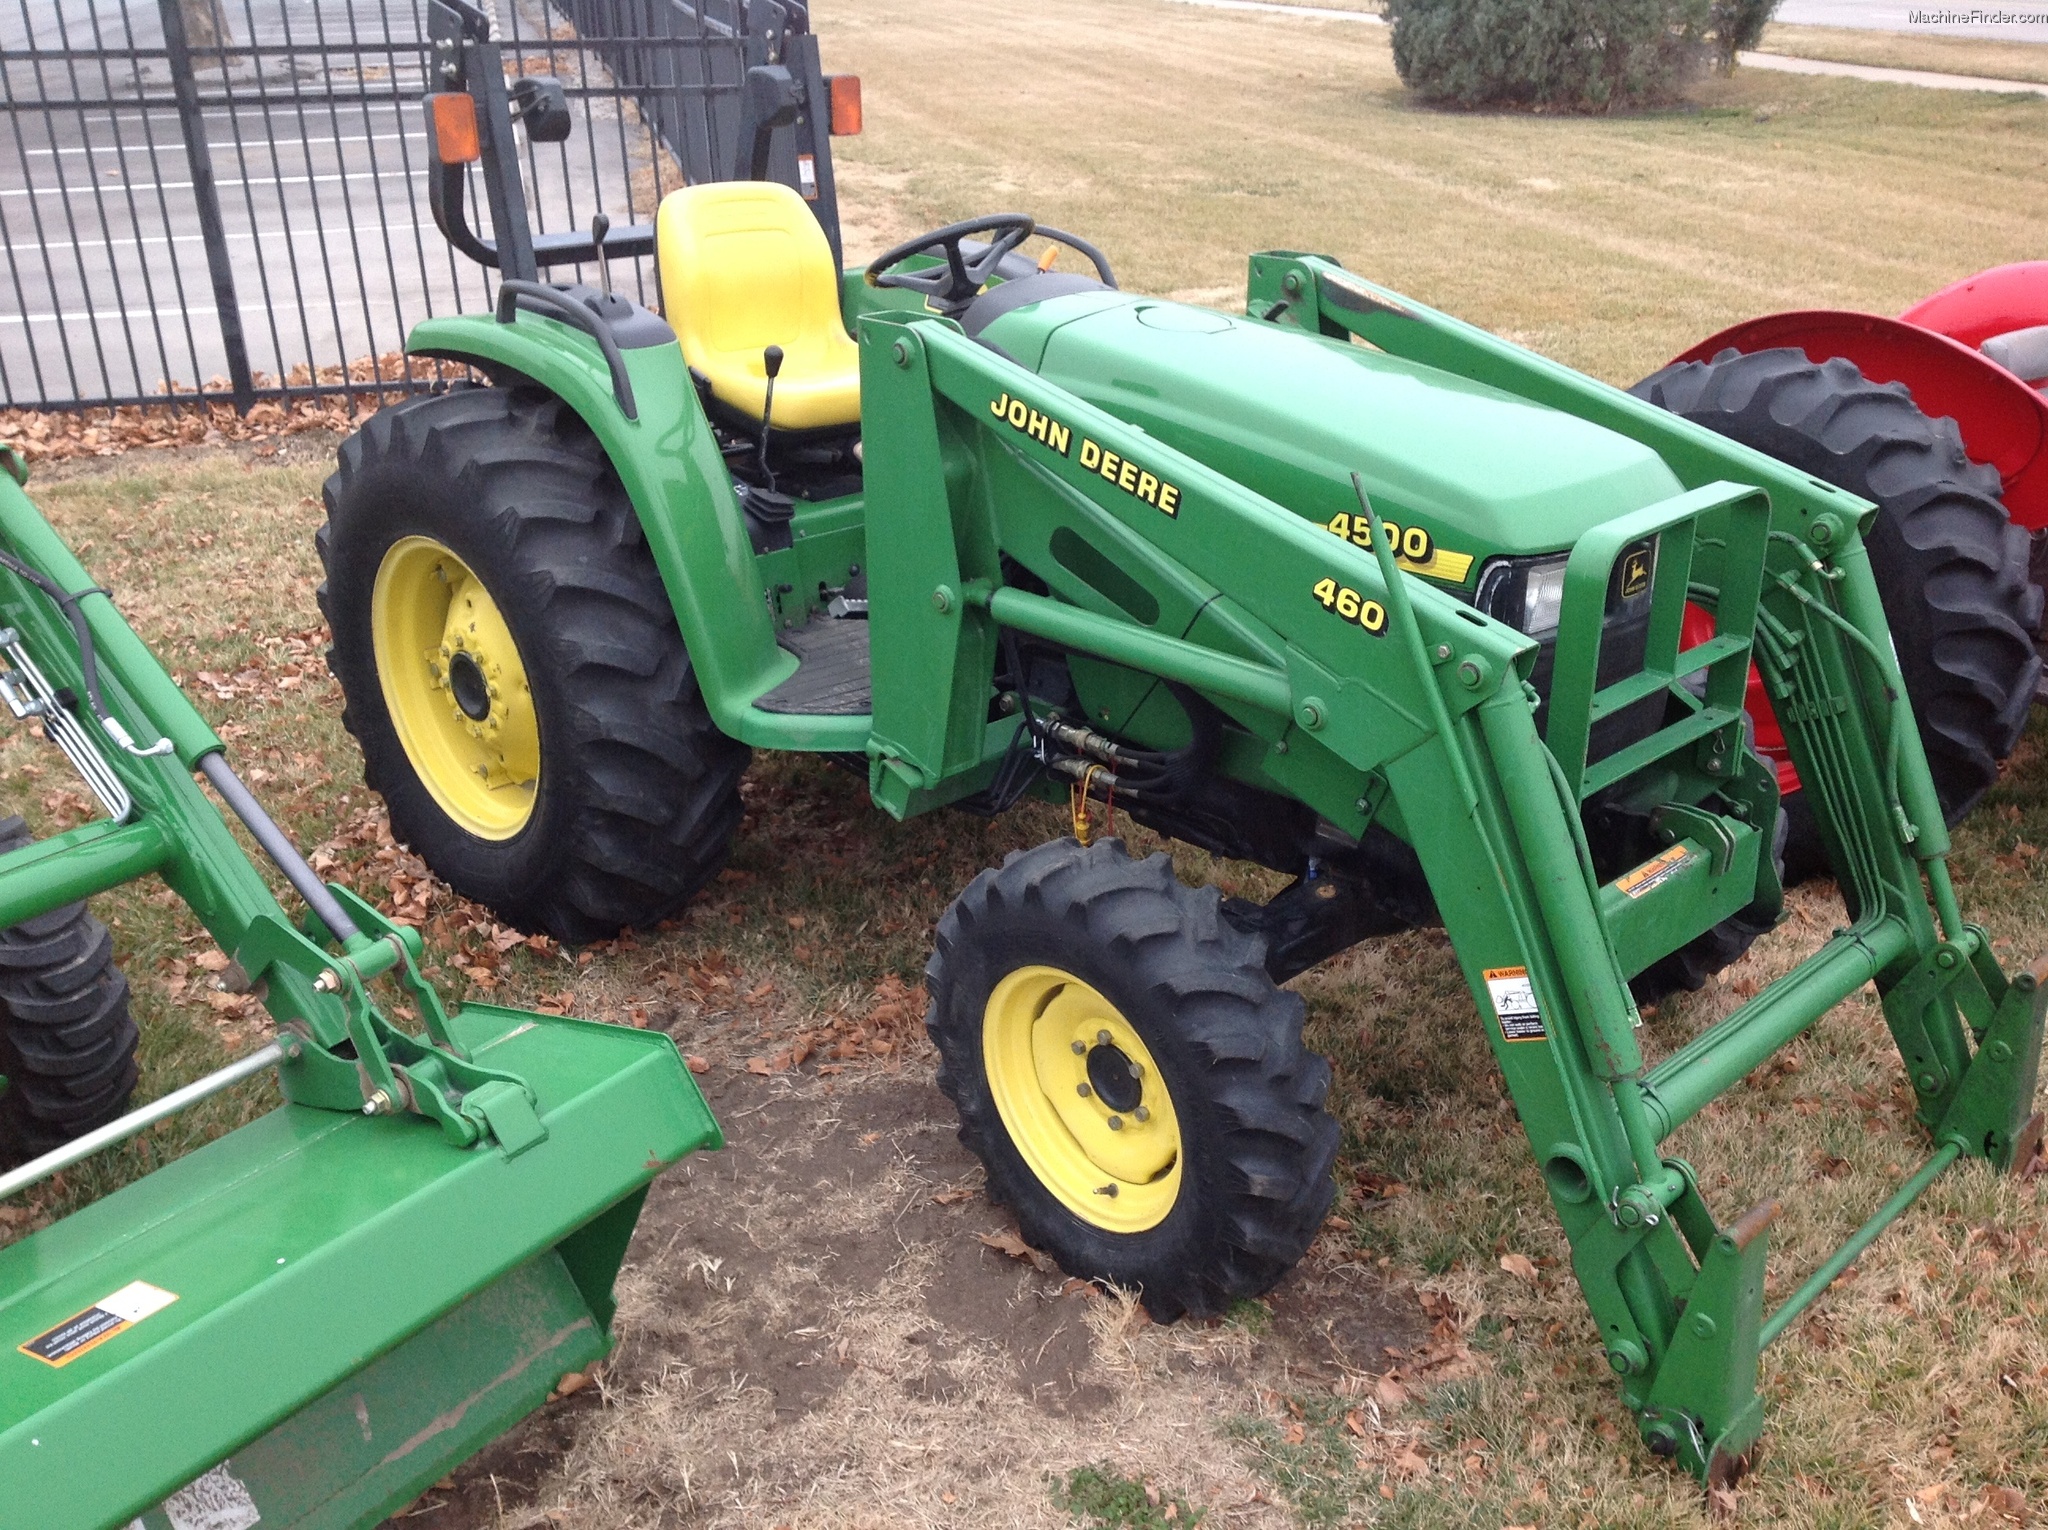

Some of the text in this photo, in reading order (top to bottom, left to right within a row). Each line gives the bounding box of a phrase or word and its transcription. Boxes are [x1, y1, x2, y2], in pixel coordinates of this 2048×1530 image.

[990, 392, 1182, 520] JOHN DEERE
[1312, 577, 1389, 638] 460
